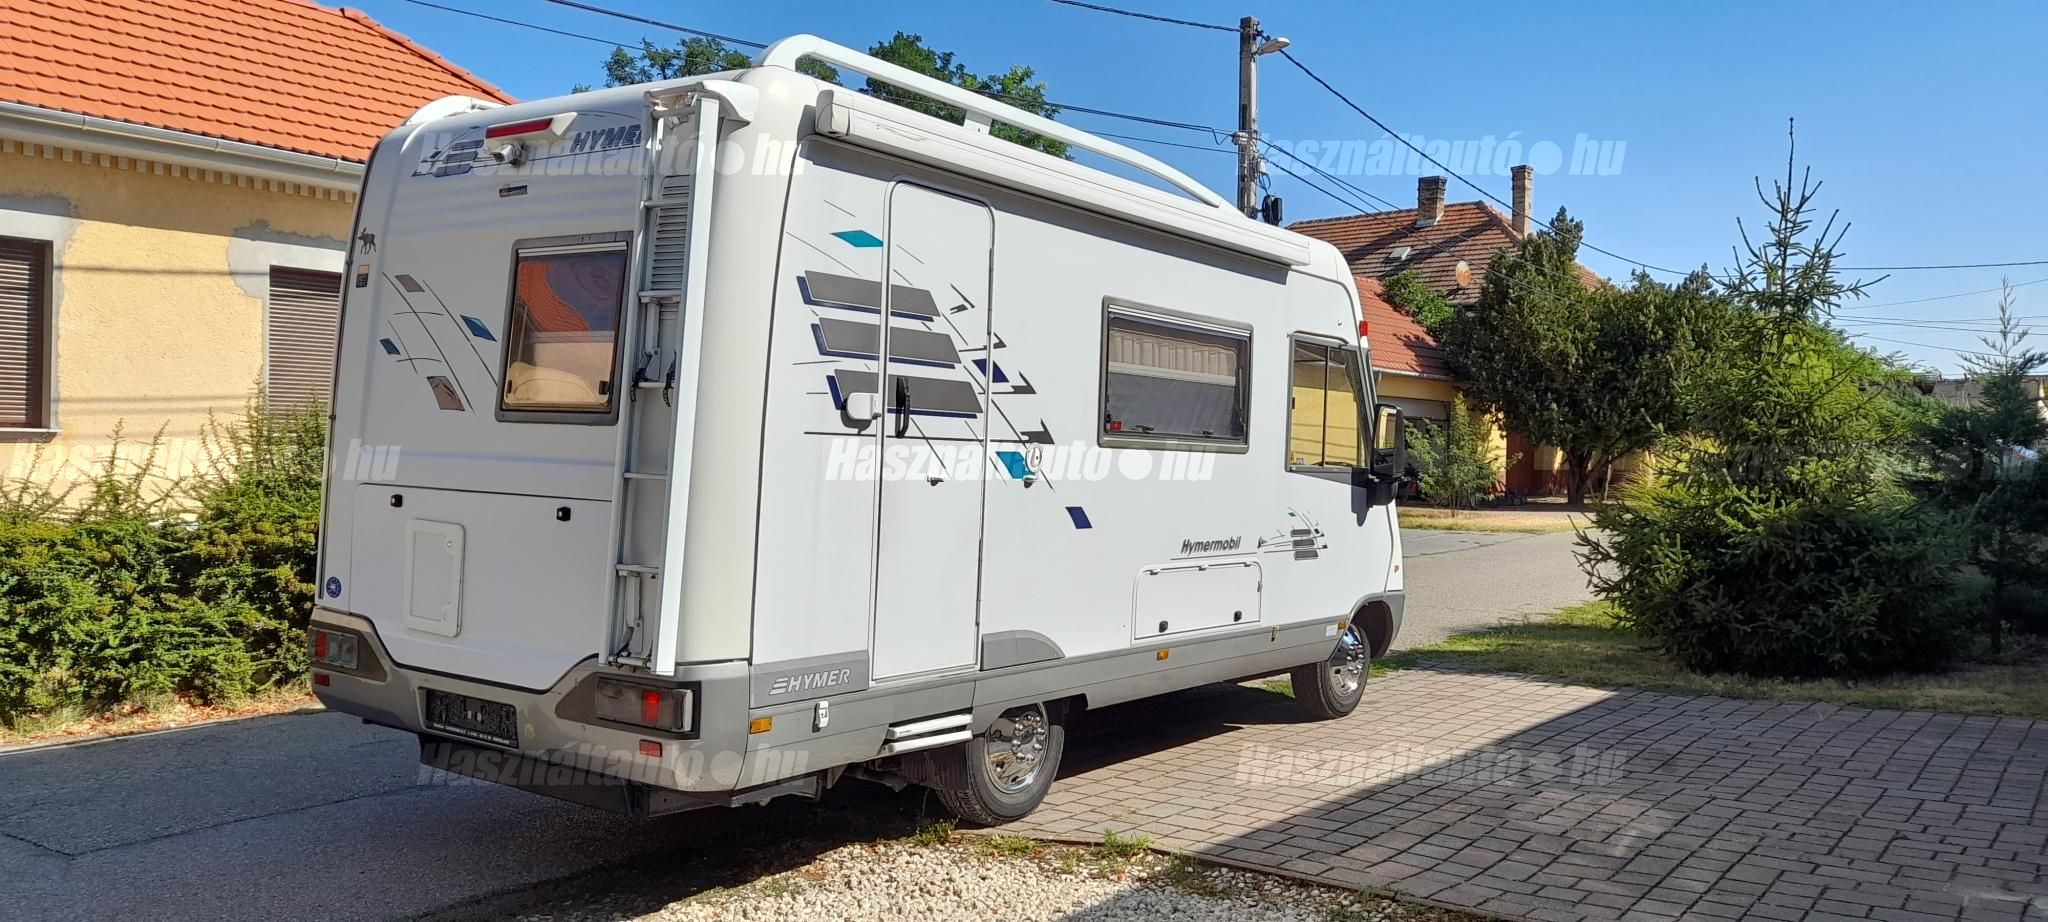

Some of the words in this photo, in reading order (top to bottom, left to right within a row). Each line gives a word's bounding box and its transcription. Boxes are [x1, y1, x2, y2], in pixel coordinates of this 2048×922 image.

[570, 124, 641, 153] HYME
[1180, 536, 1242, 556] Hymermobil
[787, 668, 851, 693] HYMER
